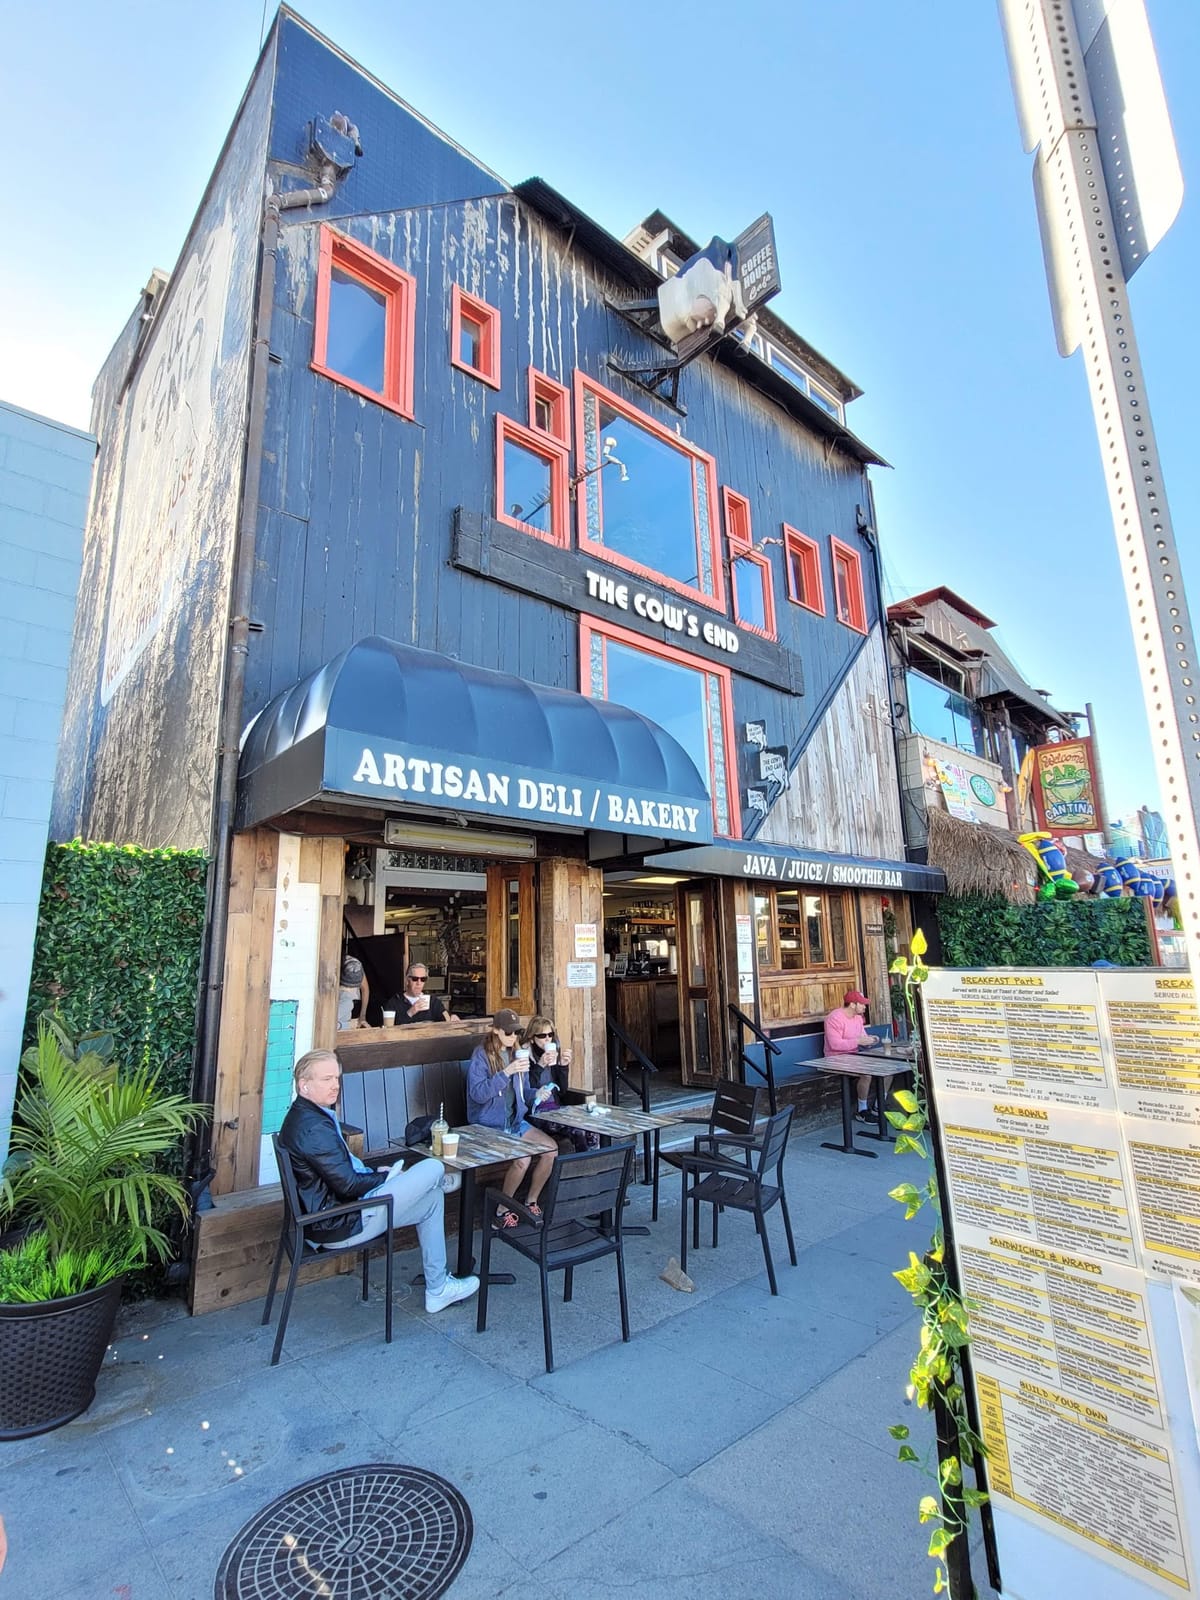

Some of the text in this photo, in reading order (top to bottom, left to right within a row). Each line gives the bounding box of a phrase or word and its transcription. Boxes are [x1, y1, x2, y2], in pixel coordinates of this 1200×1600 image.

[741, 243, 773, 277] COFFEE
[743, 257, 774, 290] HOUSE
[586, 570, 739, 653] THE COW'S END
[353, 747, 700, 833] ARTISAN DELI / BAKERY
[1045, 801, 1095, 822] CANTINA
[743, 854, 903, 887] JAVA / JUICE / SMOOTHIE BAR
[961, 976, 1010, 985] BREAKFAST
[1015, 976, 1034, 985] Part
[1155, 979, 1193, 989] BREAK
[1019, 1108, 1048, 1120] BOWLS
[988, 1236, 1046, 1259] SANDWICHES
[1061, 1255, 1102, 1274] WRAPPS
[1019, 1380, 1108, 1423] BUILD YOUR OWN
